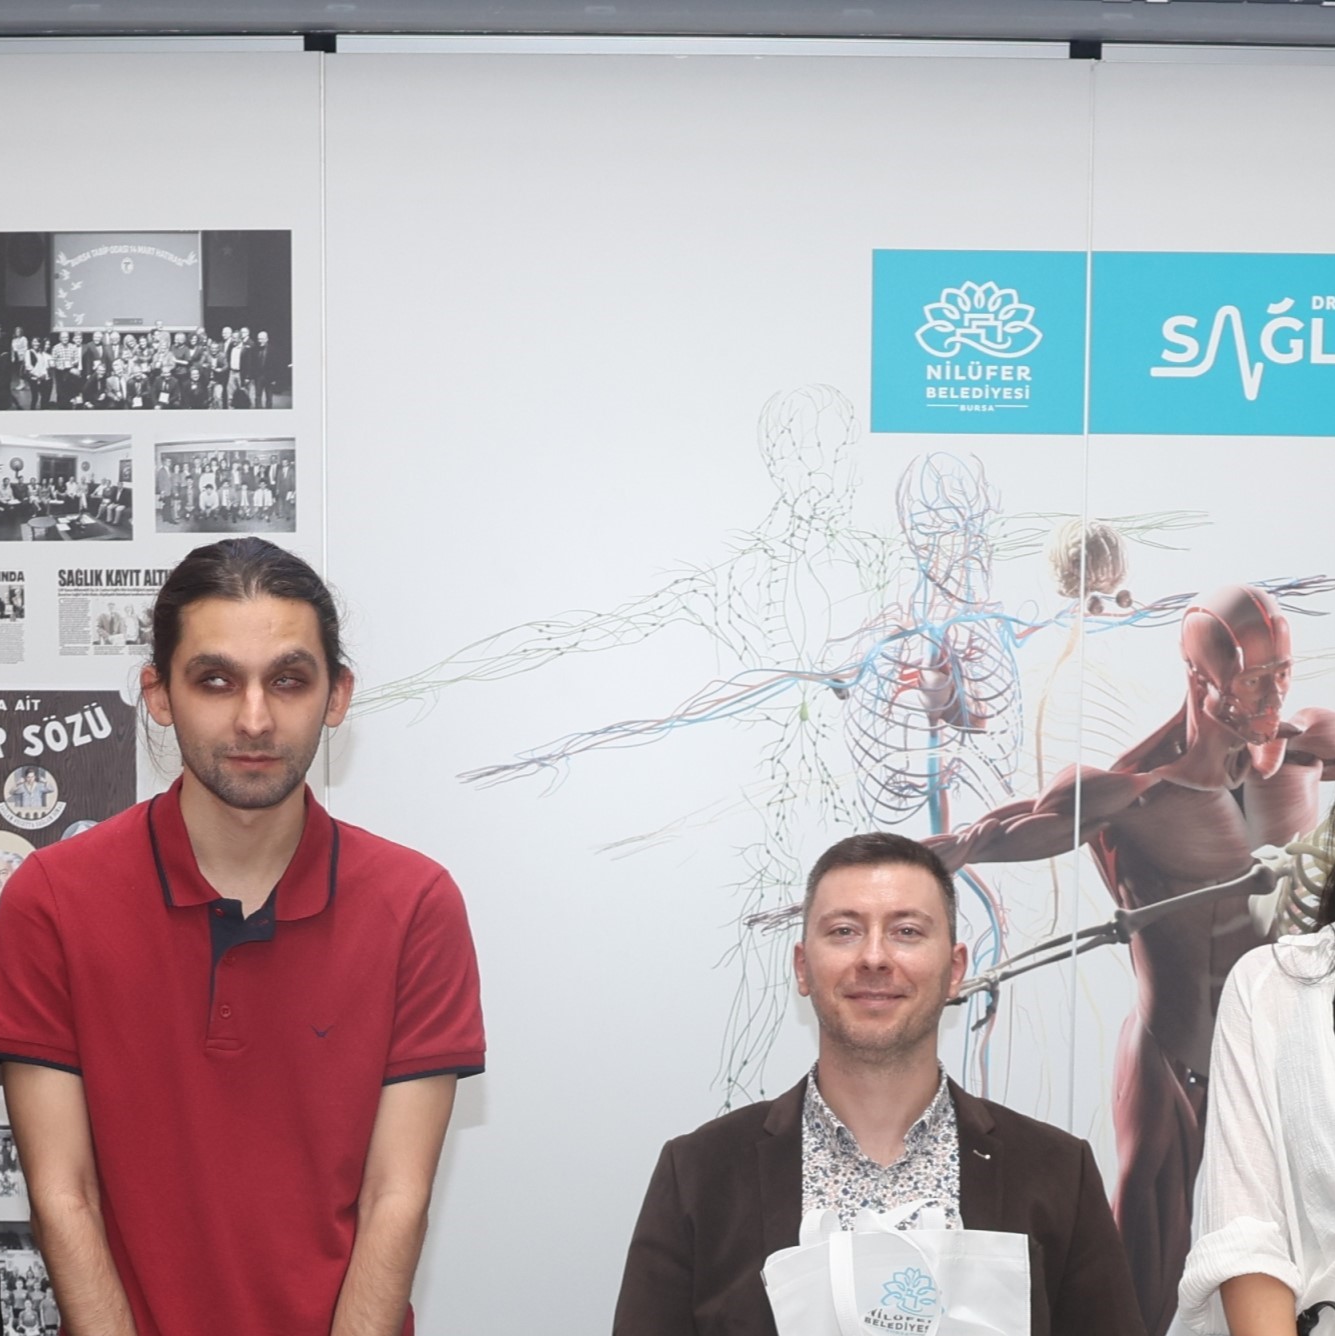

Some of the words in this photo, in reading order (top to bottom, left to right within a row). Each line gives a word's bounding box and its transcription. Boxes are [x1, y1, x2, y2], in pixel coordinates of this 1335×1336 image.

[926, 361, 1032, 381] NİLÜFER
[926, 384, 1030, 399] BELEDİYESİ
[959, 404, 995, 412] BURSA
[58, 568, 103, 587] SAĞLIK
[105, 569, 141, 587] KAYIT
[14, 695, 41, 711] AİT
[22, 702, 113, 757] SÖZÜ
